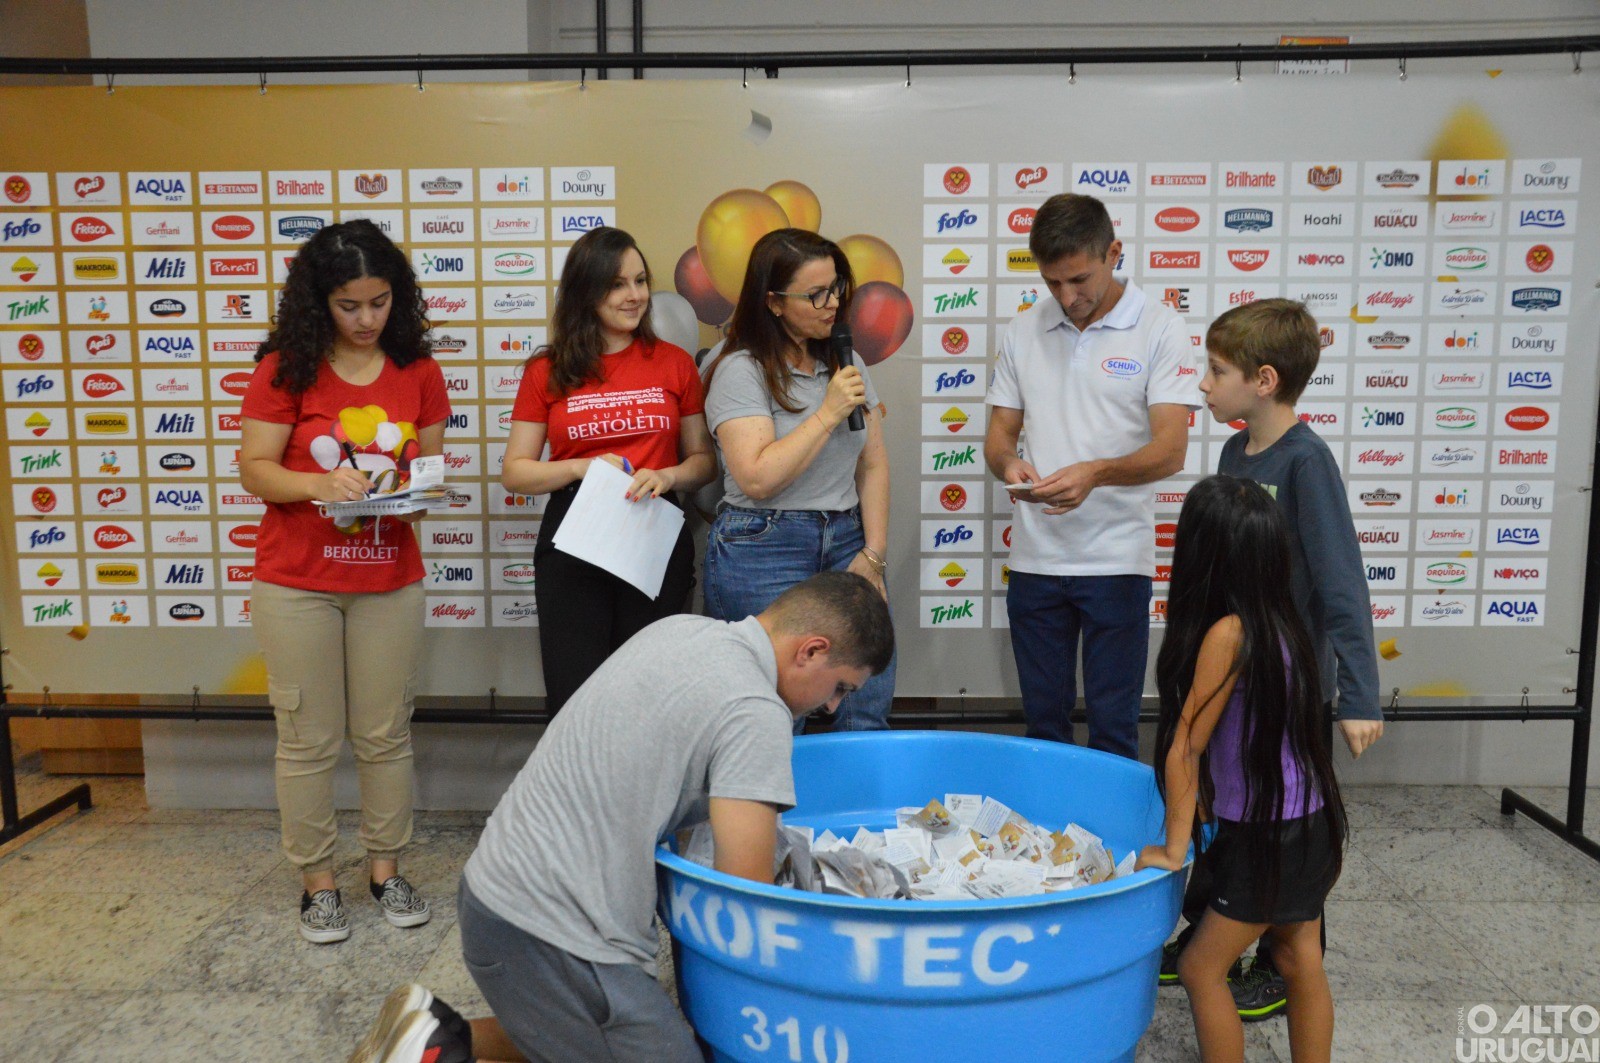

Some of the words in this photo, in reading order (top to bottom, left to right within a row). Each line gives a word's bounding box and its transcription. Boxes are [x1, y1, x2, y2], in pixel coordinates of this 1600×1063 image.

[1019, 171, 1042, 183] Apti
[1078, 170, 1131, 187] AQUA
[1162, 176, 1204, 184] BETTANIN
[1226, 172, 1275, 188] Brilhante
[1455, 169, 1489, 186] dori
[1524, 174, 1568, 189] Downy
[77, 179, 100, 193] Apti
[135, 179, 185, 196] AQUA
[217, 184, 256, 193] BETTANIN
[277, 180, 324, 196] Brilhante
[497, 177, 529, 195] dori
[563, 181, 604, 196] Downy
[493, 218, 530, 230] Jasmine
[563, 216, 605, 233] LACTA
[937, 209, 977, 232] fofo
[1227, 211, 1271, 223] HELLMANN'S
[1304, 214, 1341, 225] Hoahi
[1374, 215, 1417, 228] IGUAÇU
[1448, 212, 1486, 223] Jasmine
[1520, 210, 1565, 227] LACTA
[3, 218, 41, 241] fofo
[146, 227, 180, 235] Germani
[422, 221, 464, 234] IGUAÇU
[436, 257, 464, 271] OMO
[1009, 256, 1036, 264] MAKR
[1152, 254, 1197, 265] Parati
[1232, 253, 1265, 264] NISSIN
[1385, 253, 1414, 267] OMO
[75, 263, 116, 272] MAKRODAL
[146, 258, 186, 278] Mili
[213, 262, 255, 273] Parati
[934, 288, 979, 313] Trink
[1366, 292, 1414, 308] Kellogg's
[1514, 290, 1559, 302] HELLMANN'S
[7, 296, 49, 320] Trink
[90, 337, 112, 349] Apti
[146, 337, 194, 353] AQUA
[501, 334, 531, 350] dori
[1445, 330, 1478, 348] dori
[1512, 337, 1554, 352] Downy
[1107, 360, 1136, 371] SCHUH
[936, 369, 975, 392] fofo
[1366, 376, 1408, 388] IGUAÇU
[1438, 373, 1476, 384] Jasmine
[1508, 372, 1552, 388] LACTA
[17, 375, 54, 398] fofo
[156, 383, 189, 391] Germani
[567, 401, 633, 414] BERTOLETTI
[593, 409, 644, 420] SUPER
[87, 419, 126, 427] MAKRODAL
[155, 413, 195, 433] Mili
[1377, 411, 1404, 426] OMO
[567, 415, 670, 440] BERTOLETTI
[21, 450, 62, 474] Trink
[932, 446, 976, 470] Trink
[1358, 450, 1404, 466] Kellogg's
[1499, 450, 1548, 465] Brilhante
[100, 490, 121, 503] Apti
[155, 491, 204, 507] AQUA
[1435, 488, 1468, 504] dori
[1501, 495, 1542, 509] Downy
[30, 526, 66, 548] fofo
[433, 533, 473, 545] IGUAÇU
[503, 531, 537, 540] Jasmine
[935, 525, 973, 548] fofo
[1358, 532, 1399, 544] IGUAÇU
[1429, 529, 1465, 540] Jasmine
[1497, 528, 1539, 544] LACTA
[98, 569, 137, 577] MAKRODAL
[165, 564, 204, 584] Mili
[446, 567, 472, 581] OMO
[1368, 566, 1396, 580] OMO
[33, 599, 73, 622] Trink
[432, 604, 477, 619] Kellogg's
[930, 600, 974, 624] Trink
[1488, 602, 1538, 618] AQUA
[671, 883, 802, 969] KOF
[832, 921, 1035, 987] TEC
[740, 1006, 849, 1063] 310
